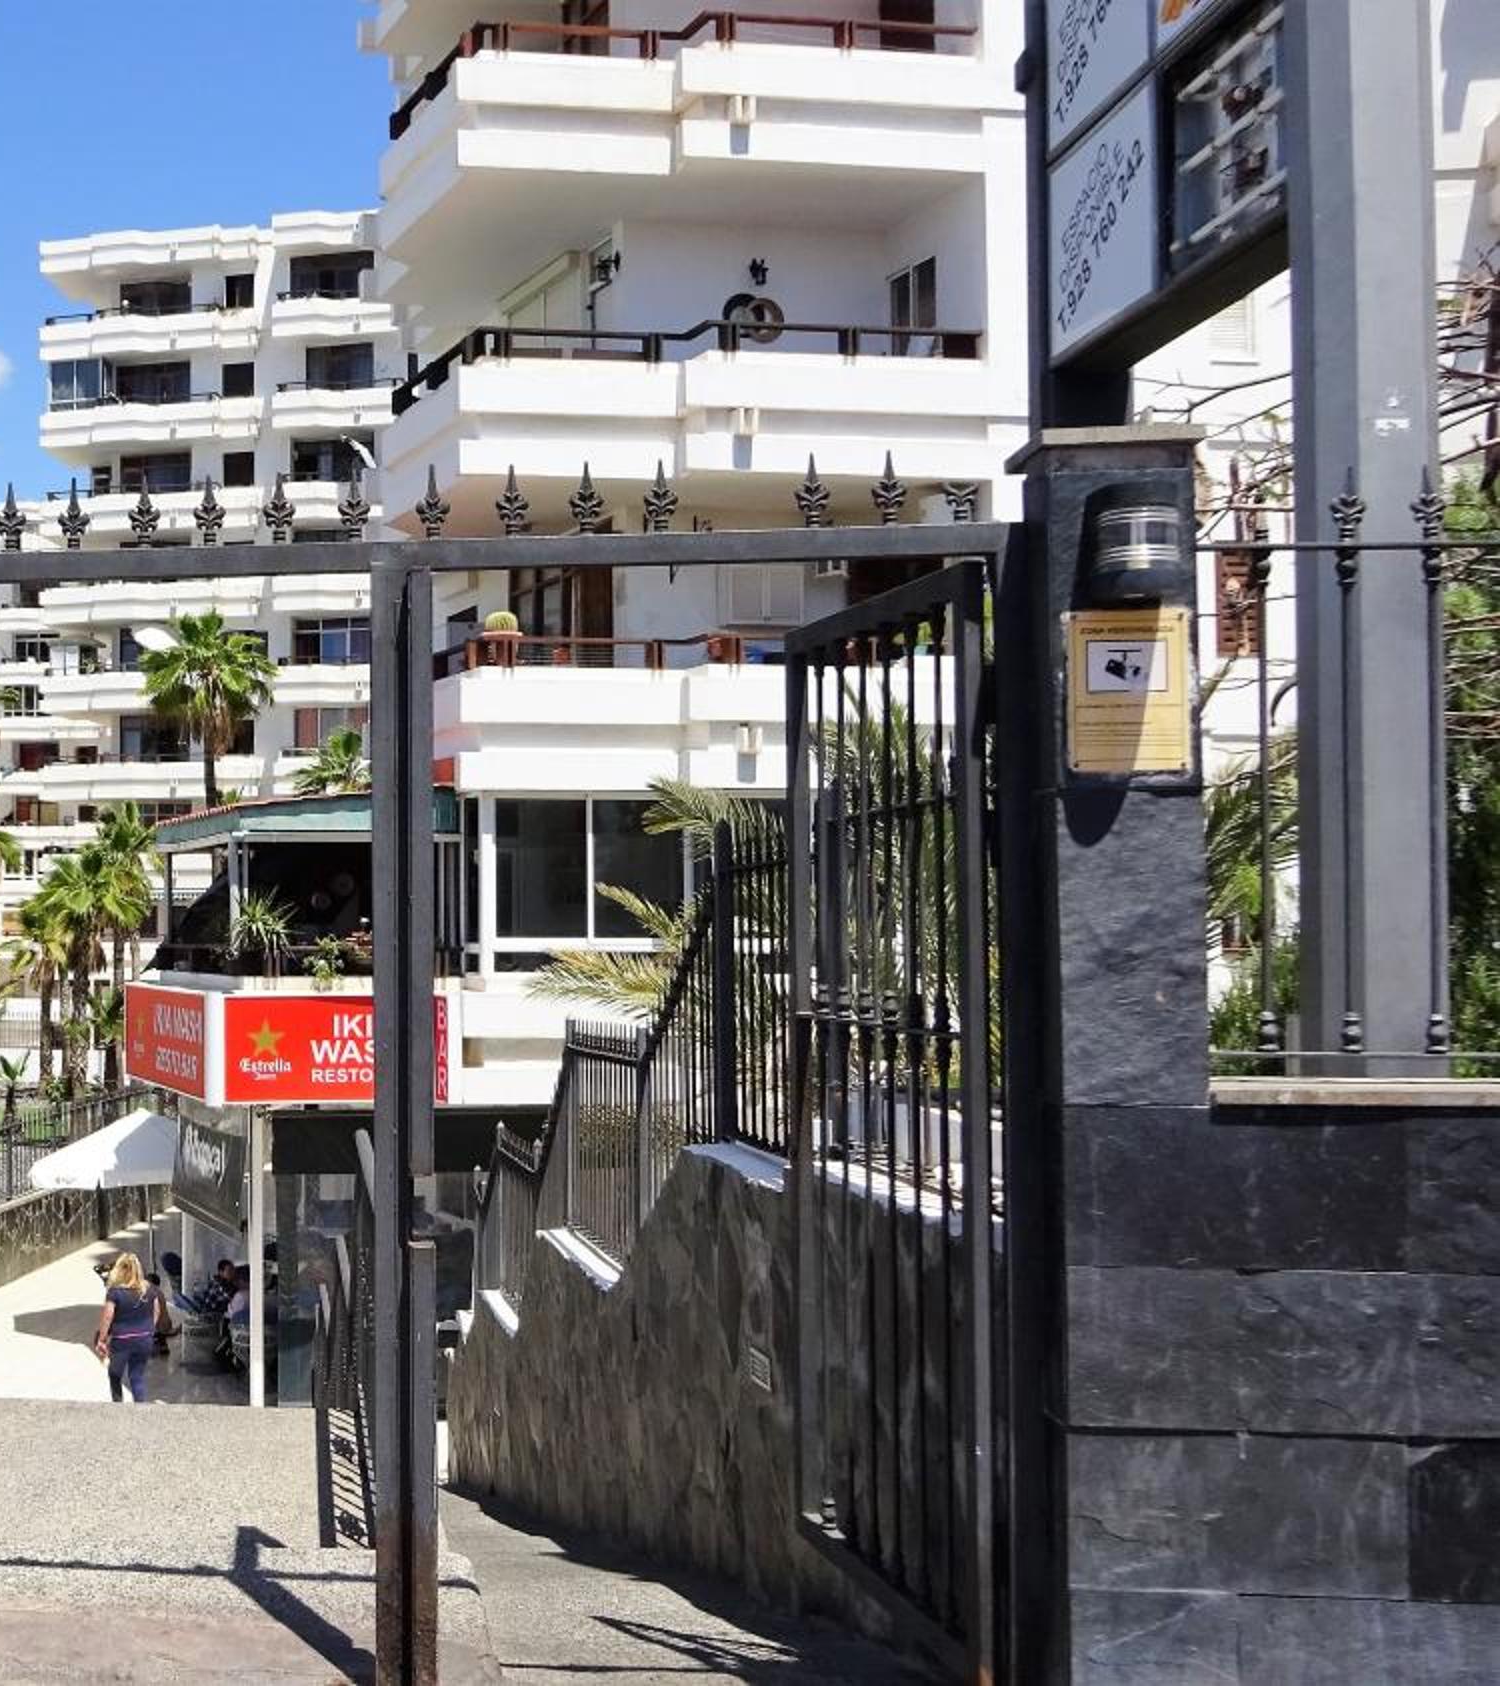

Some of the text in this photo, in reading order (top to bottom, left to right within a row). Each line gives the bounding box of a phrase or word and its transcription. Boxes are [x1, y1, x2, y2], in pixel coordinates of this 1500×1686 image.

[1088, 0, 1113, 43] 76
[1058, 139, 1145, 333] T.928 760 242
[1059, 143, 1125, 293] DISPONIBLE
[1062, 142, 1108, 254] ESPACIO
[239, 1056, 292, 1073] Estrella
